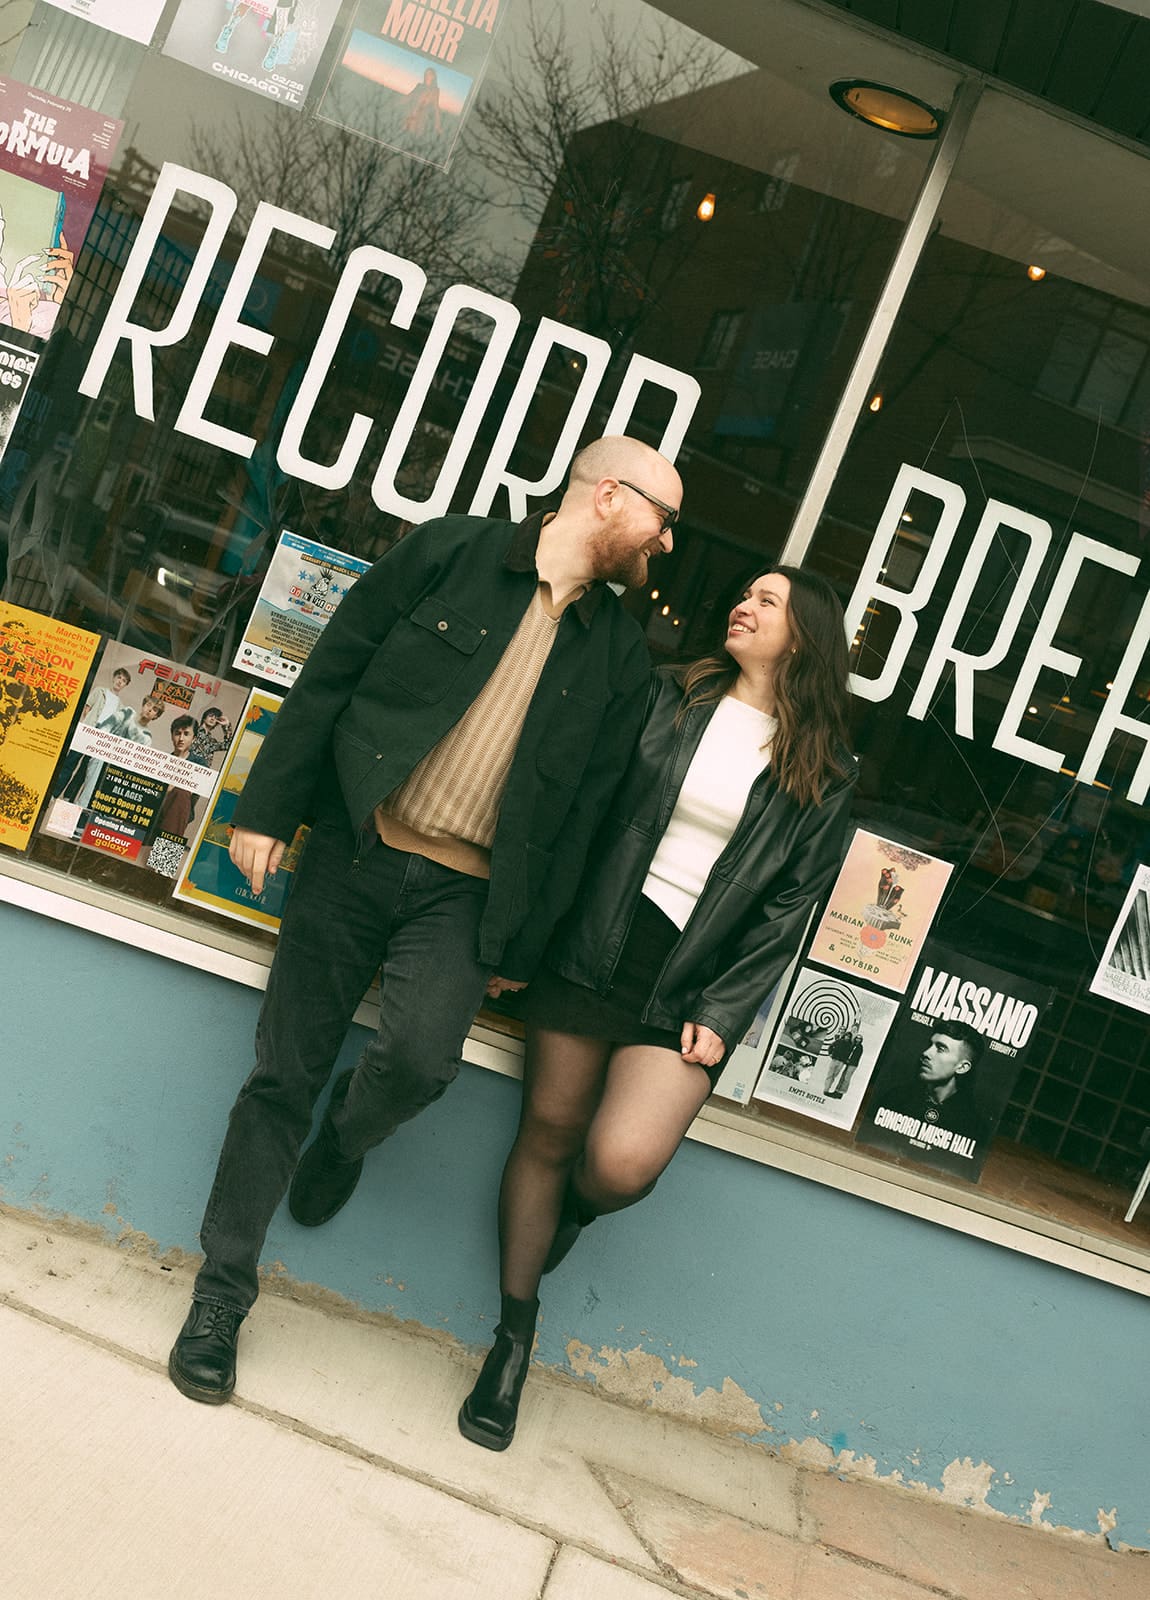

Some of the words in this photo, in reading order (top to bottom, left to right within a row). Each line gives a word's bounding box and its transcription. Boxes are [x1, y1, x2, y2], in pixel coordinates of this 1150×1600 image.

[381, 0, 464, 63] MURR
[212, 62, 281, 98] CHICAGO,
[285, 91, 299, 104] IL
[24, 108, 57, 136] THE
[0, 120, 90, 180] ORMULA
[55, 625, 82, 641] March
[84, 636, 95, 645] 14
[67, 640, 78, 648] For
[79, 644, 91, 653] The
[12, 639, 74, 671] LEGION
[14, 669, 75, 700] REALLY
[22, 660, 80, 690] THERE
[81, 725, 122, 745] TRANSPORT
[124, 741, 134, 749] TO
[135, 744, 167, 761] ANOTHER
[169, 756, 192, 770] WORLD
[193, 765, 212, 776] WITH
[95, 738, 111, 749] OUR
[85, 744, 132, 766] PSYCHEDELIC
[133, 760, 156, 774] SONIC
[157, 769, 199, 790] EXPERIENCE
[125, 772, 155, 788] FEBRUARY
[130, 782, 159, 797] BELMONT
[94, 789, 117, 804] Doors
[115, 797, 136, 812] Open
[135, 804, 142, 813] 6
[141, 806, 154, 817] PM
[112, 784, 125, 796] ALL
[124, 789, 143, 802] AGES
[90, 799, 112, 814] Show
[115, 808, 128, 819] PM
[131, 813, 138, 822] 9
[137, 816, 150, 827] PM
[93, 815, 119, 831] Opening
[119, 824, 135, 836] Band
[89, 827, 131, 849] dinosaur
[94, 835, 129, 856] galaxy
[160, 831, 184, 844] TICKETS
[829, 910, 863, 928] MARIAN
[888, 932, 913, 946] RUNK
[828, 943, 836, 951] &
[839, 954, 880, 974] JOYBIRD
[910, 966, 1038, 1049] MASSANO
[988, 1039, 1012, 1055] FEBRUARY
[788, 1085, 806, 1097] EMPTY
[804, 1092, 825, 1104] BOTTLE
[873, 1106, 922, 1138] CONCORD
[916, 1121, 953, 1149] MUSIC
[948, 1133, 978, 1159] HALL
